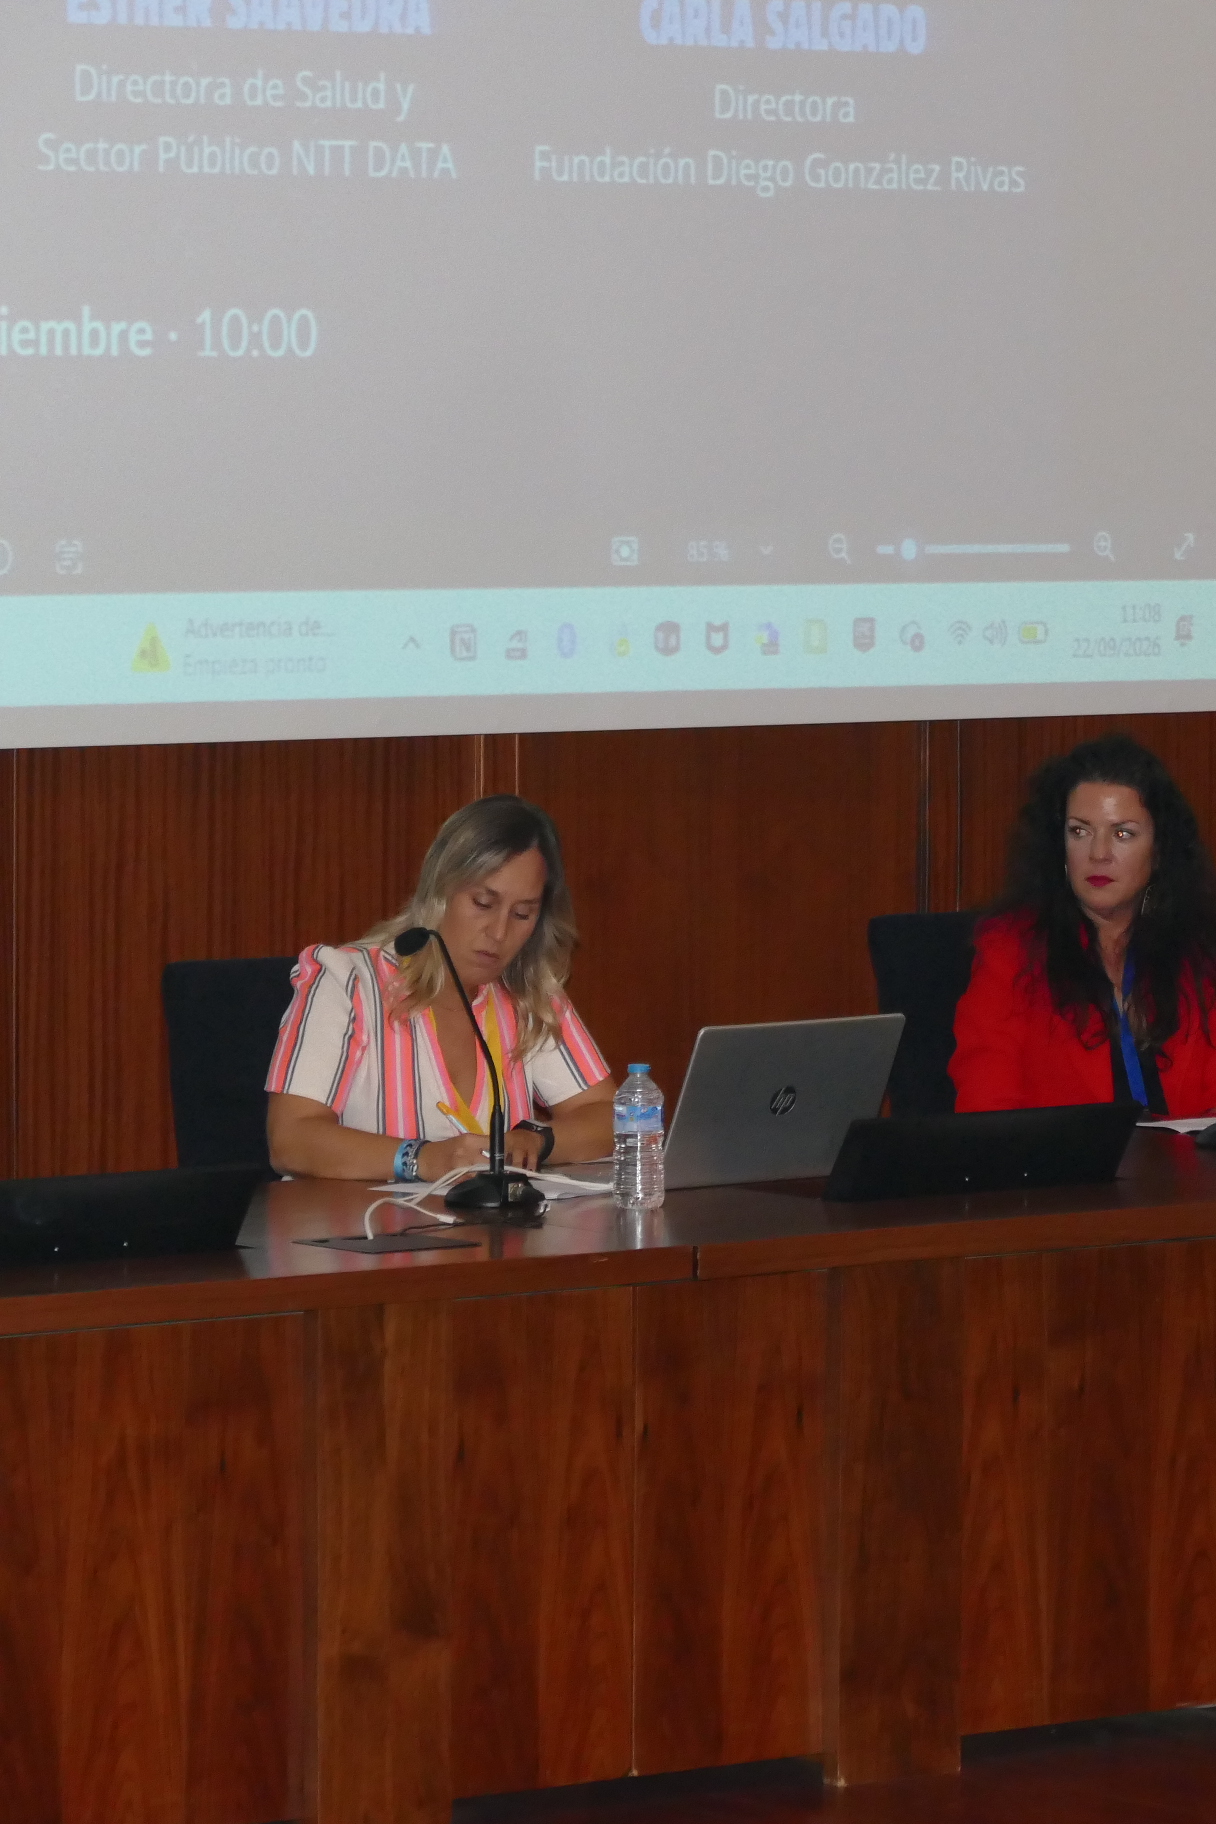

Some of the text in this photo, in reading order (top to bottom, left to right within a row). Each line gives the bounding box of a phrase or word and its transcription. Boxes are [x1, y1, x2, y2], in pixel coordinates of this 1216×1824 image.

[639, 0, 928, 54] CARLA SALGADO
[74, 63, 416, 122] Directora de Salud y
[714, 83, 856, 123] Directora
[37, 132, 457, 179] Sector Público NTT DATA
[534, 144, 1027, 197] Fundación Diego González Rivas
[0, 305, 319, 358] iembre 10:00
[184, 617, 294, 639] Advertencia
[1120, 602, 1162, 624] 11:08
[183, 653, 328, 679] Empieza pronto
